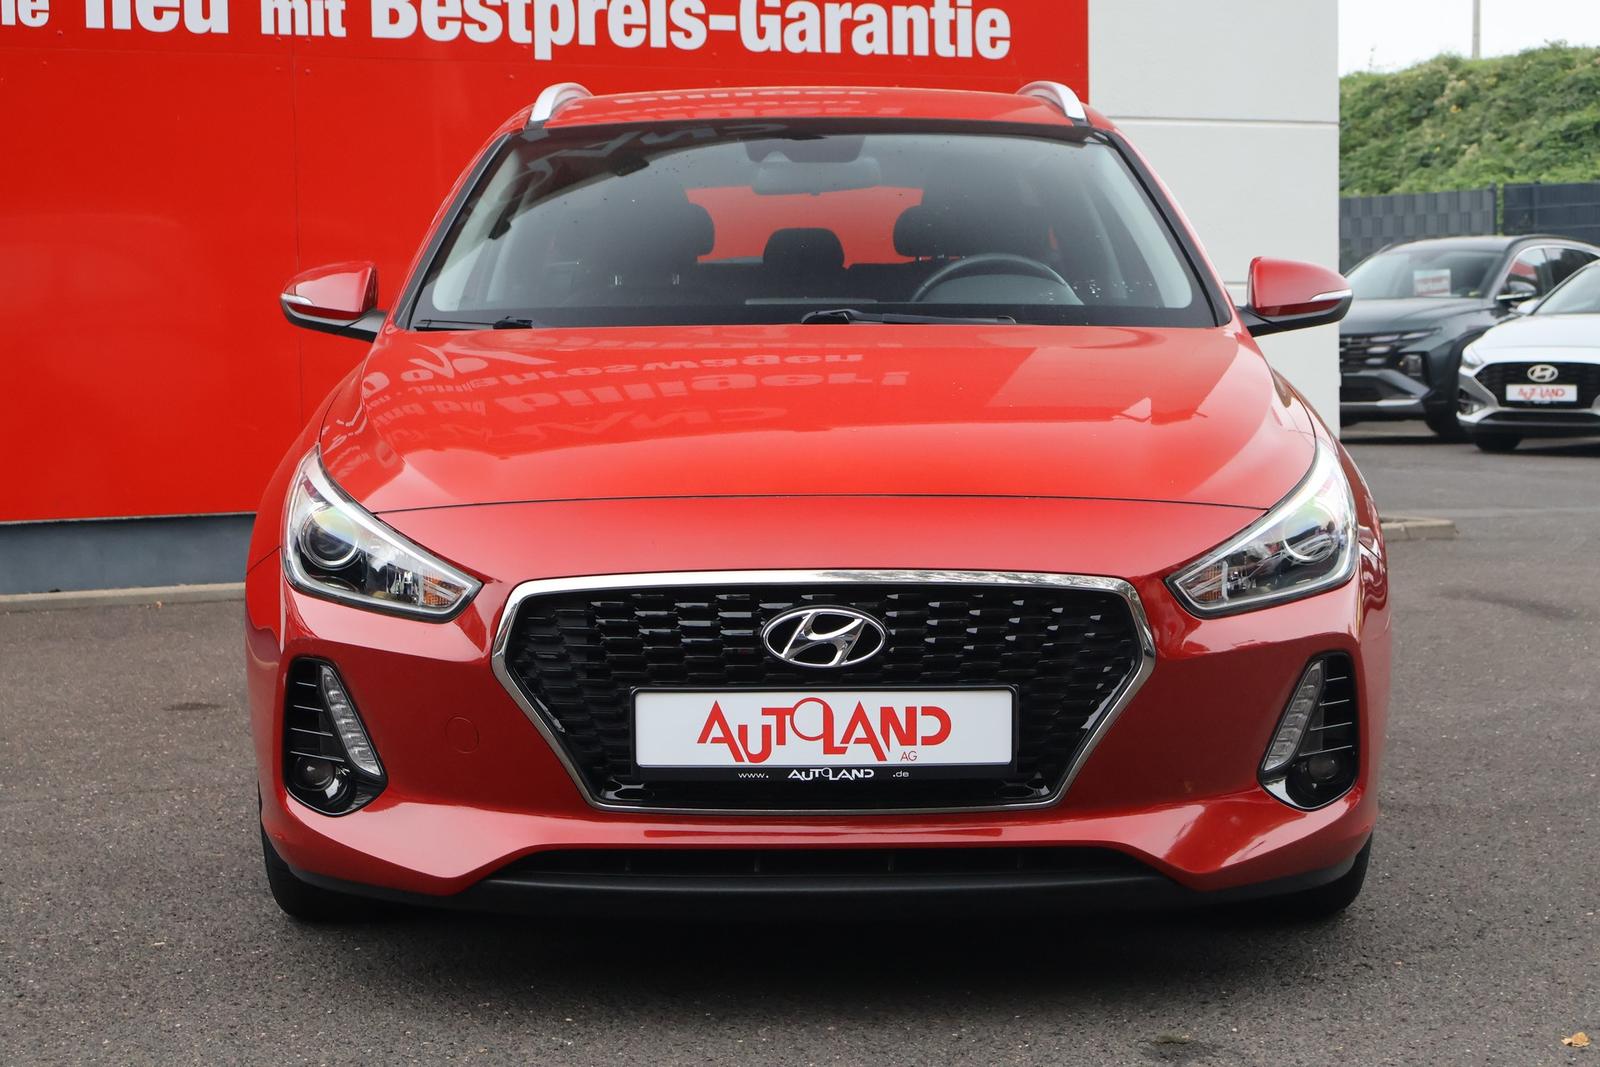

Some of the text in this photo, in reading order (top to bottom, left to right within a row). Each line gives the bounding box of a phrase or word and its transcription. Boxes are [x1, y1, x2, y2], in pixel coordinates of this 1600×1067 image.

[260, 0, 347, 38] mit
[371, 0, 1012, 61] Bestpreis-Garantie
[696, 697, 952, 763] AUTOLAND
[892, 770, 910, 778] .de
[900, 751, 918, 762] AG
